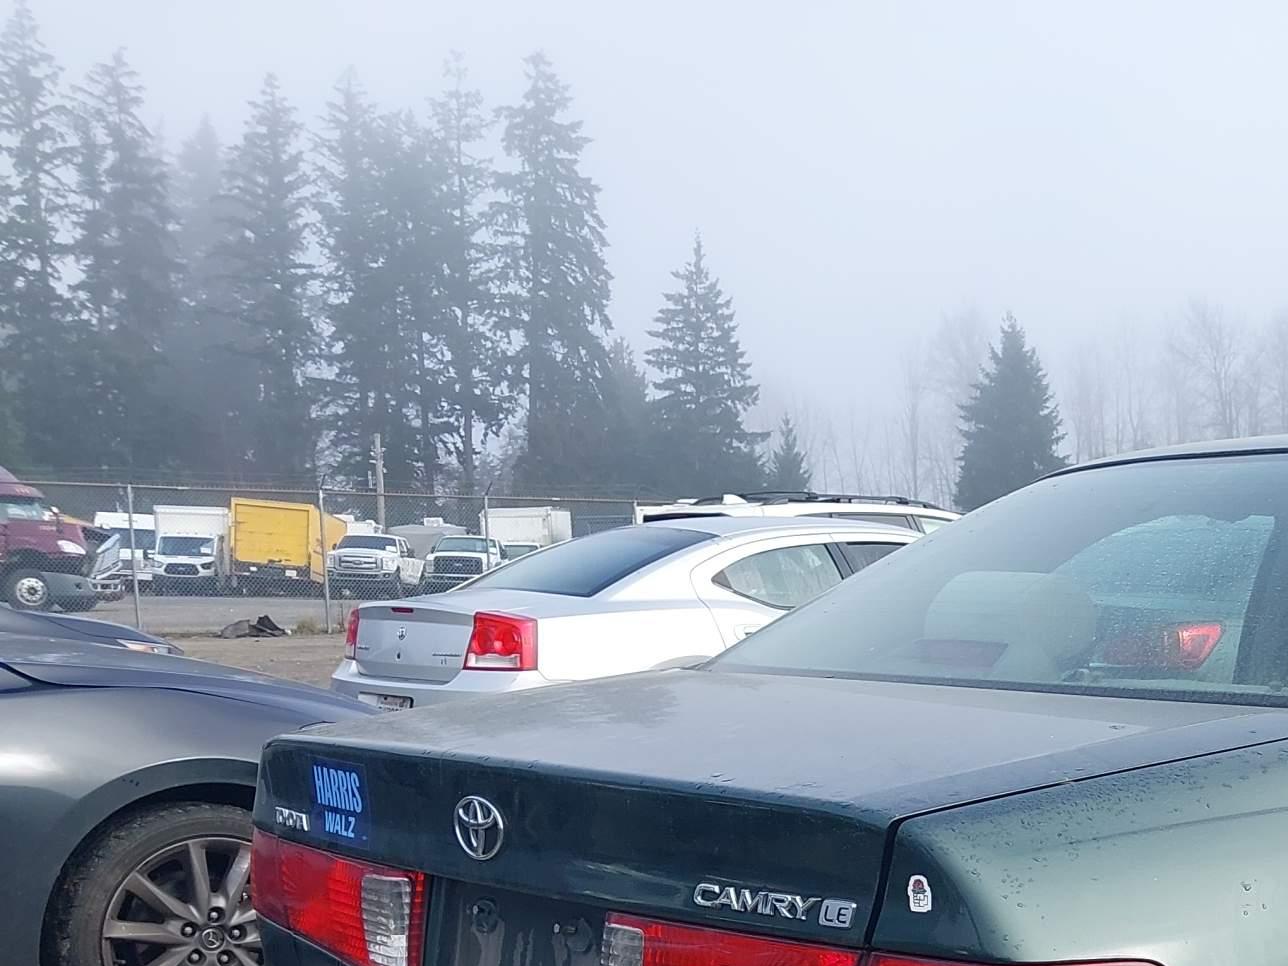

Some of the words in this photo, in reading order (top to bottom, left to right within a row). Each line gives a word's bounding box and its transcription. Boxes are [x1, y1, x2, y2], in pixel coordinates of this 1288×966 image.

[313, 765, 362, 813] HARRIS
[325, 811, 355, 838] WALZ
[693, 883, 821, 920] CAMRY
[824, 903, 849, 924] LE
